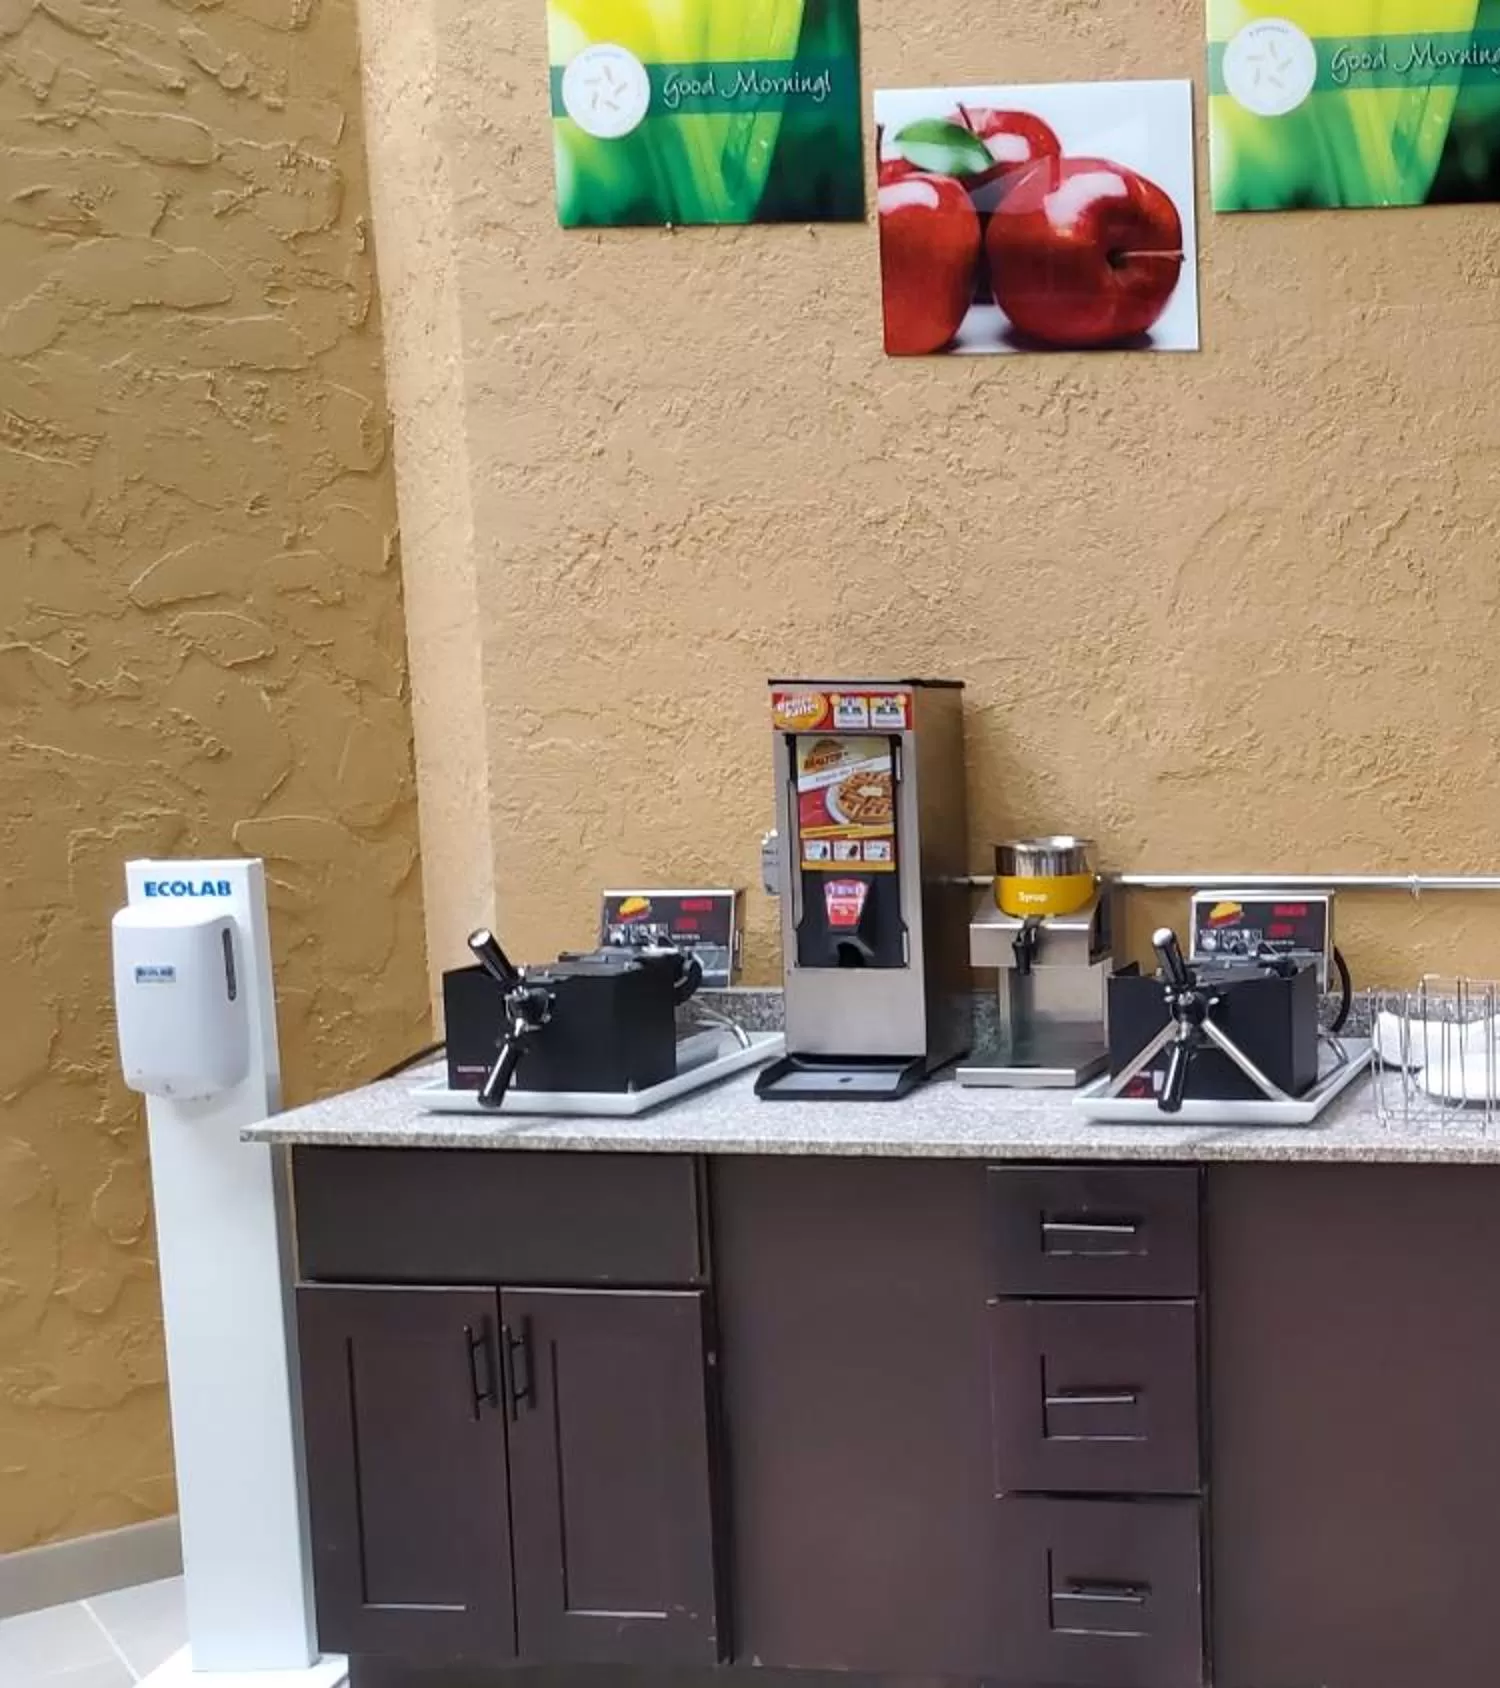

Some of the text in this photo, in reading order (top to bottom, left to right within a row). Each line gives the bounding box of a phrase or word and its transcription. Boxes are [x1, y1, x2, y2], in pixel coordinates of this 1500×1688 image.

[1331, 43, 1387, 84] Good
[663, 69, 832, 109] Good Morning!
[143, 880, 232, 897] ECOLAB
[1017, 891, 1048, 904] Syrup
